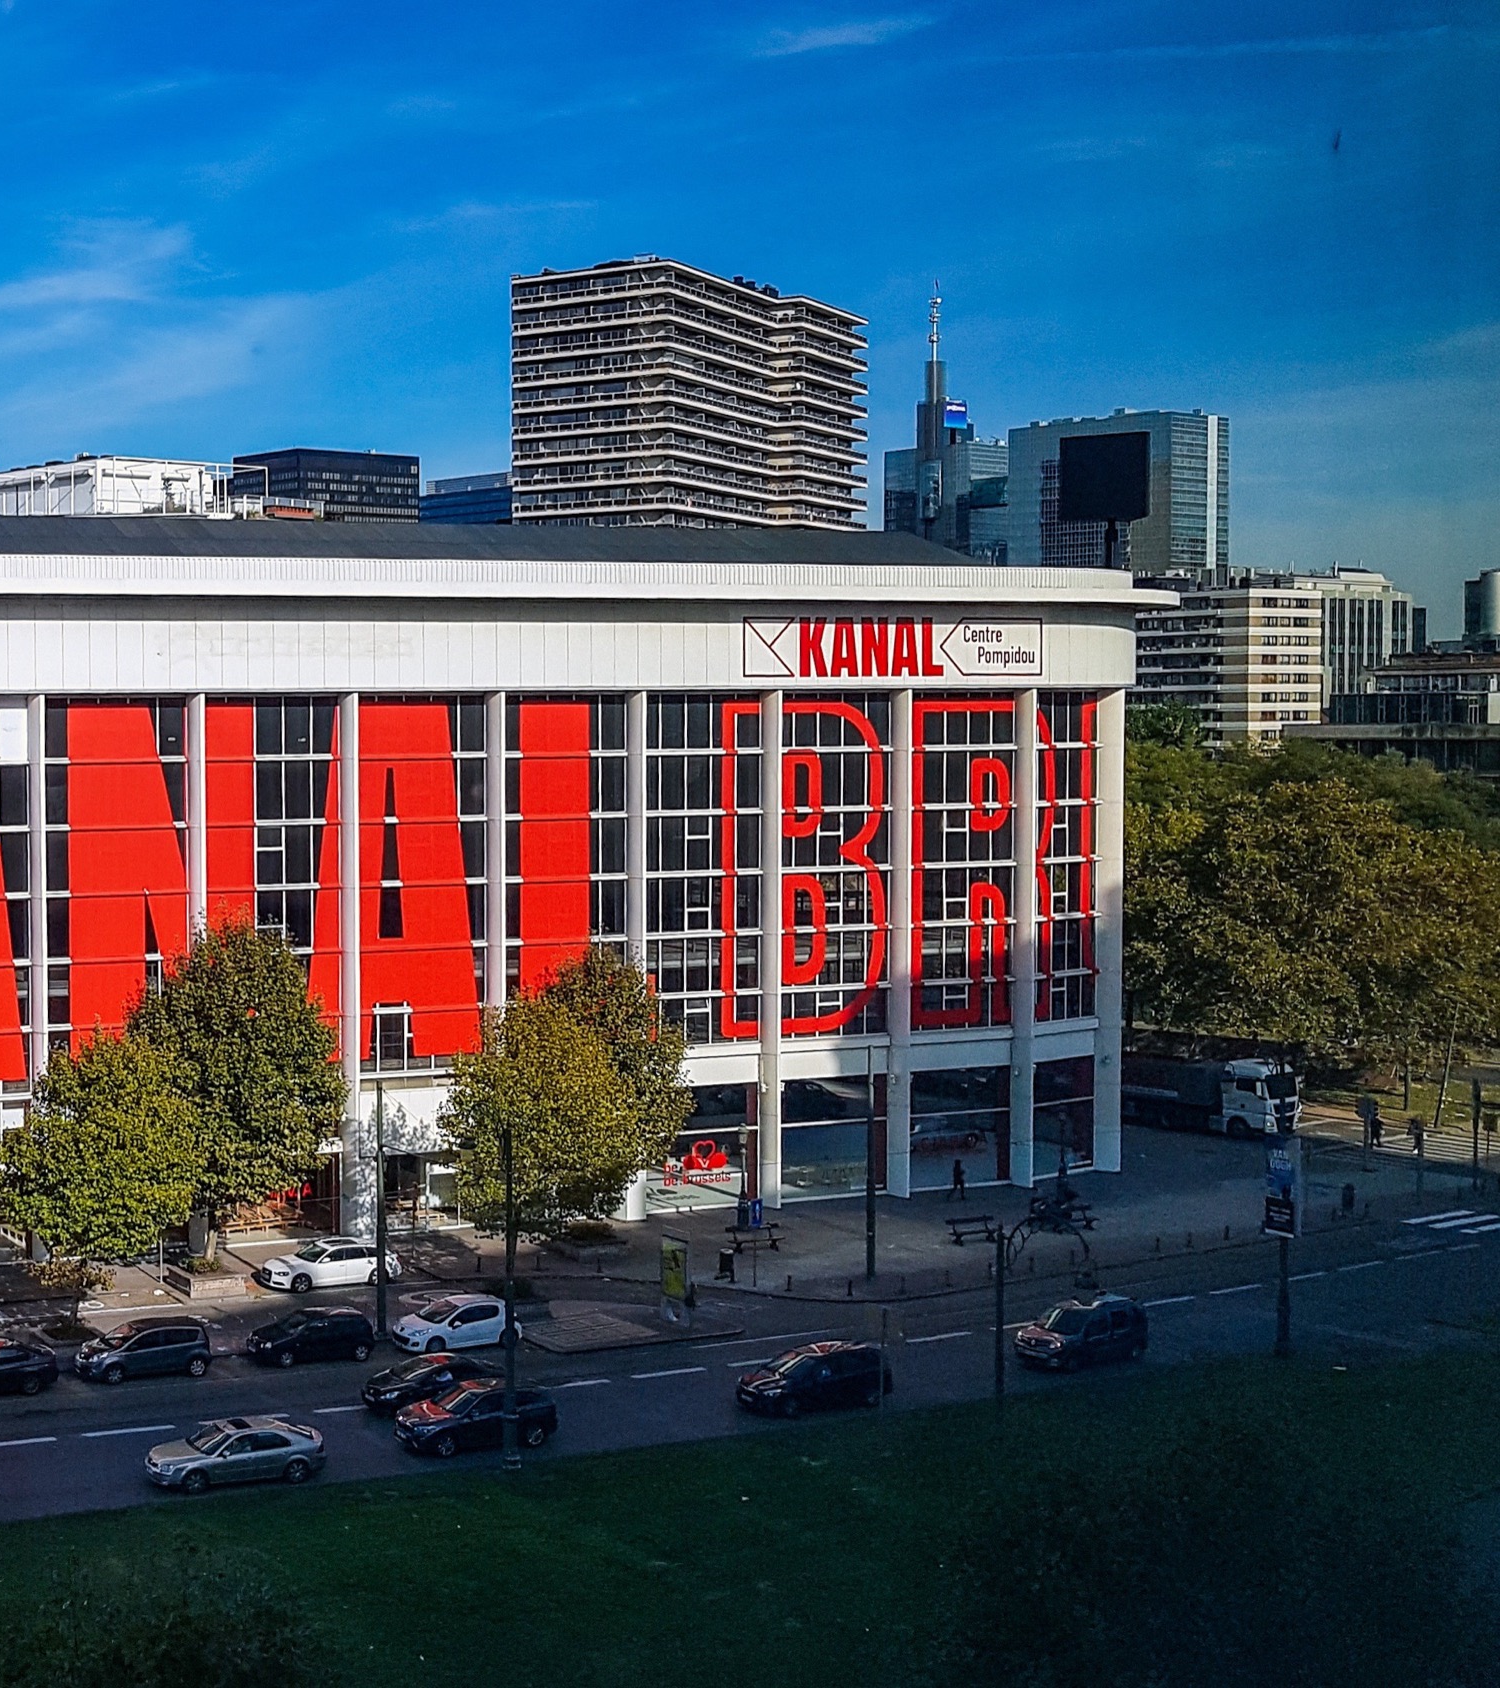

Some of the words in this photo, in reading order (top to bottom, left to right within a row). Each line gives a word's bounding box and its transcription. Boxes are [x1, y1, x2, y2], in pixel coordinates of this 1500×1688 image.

[799, 617, 944, 677] KANAL
[963, 625, 1003, 643] Centre
[977, 646, 1035, 668] Pompidou
[720, 700, 1098, 1038] BR
